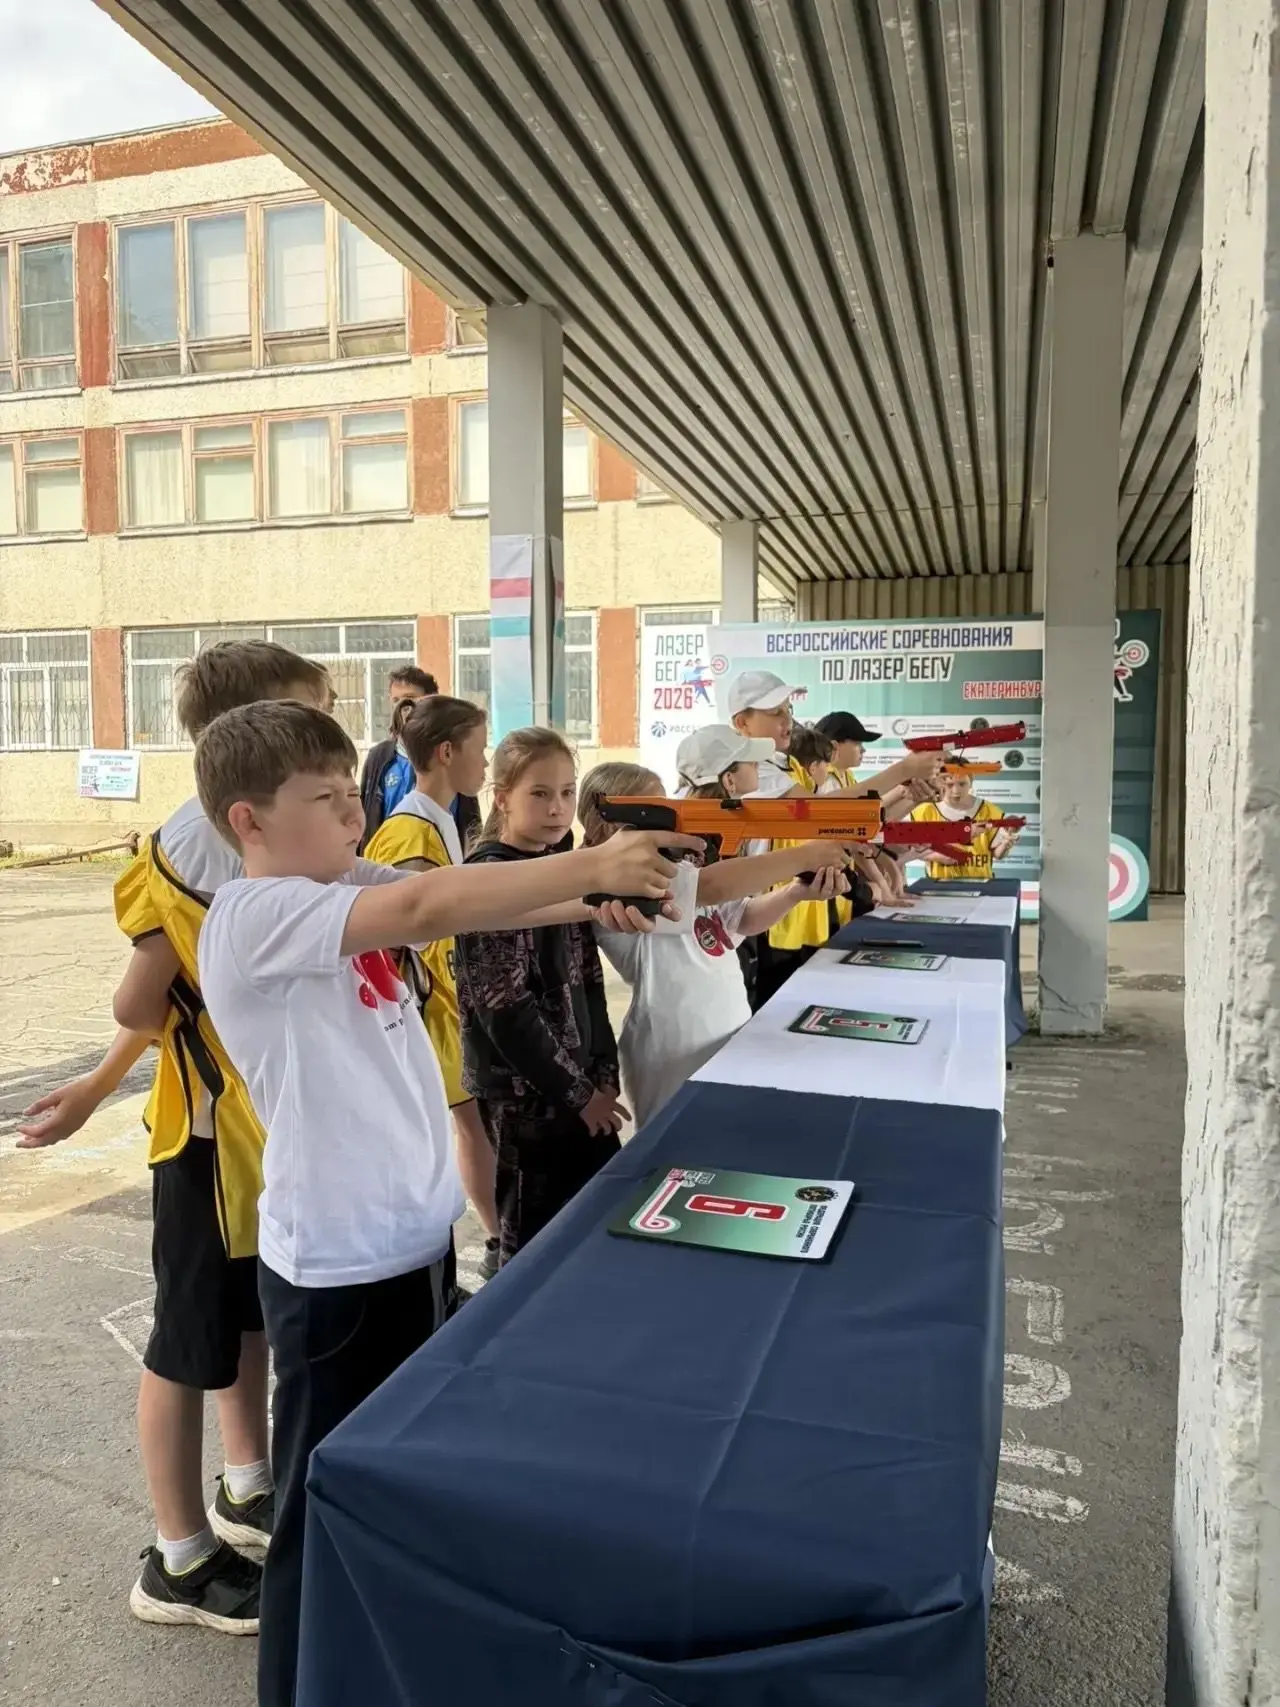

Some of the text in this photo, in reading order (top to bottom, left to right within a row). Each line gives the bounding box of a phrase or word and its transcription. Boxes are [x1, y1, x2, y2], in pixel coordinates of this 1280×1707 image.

[654, 634, 704, 656] ЛАЗЕР
[767, 626, 1013, 653] ВСЕРОССИЙСКИЕ СОРЕВНОВАНИЯ
[655, 660, 681, 682] БЕГ
[822, 656, 952, 681] ПО ЛАЗЕР БЕГУ
[654, 687, 693, 710] 2026
[964, 682, 1042, 698] ЕКАТЕРИНБУР
[686, 1194, 788, 1221] 6
